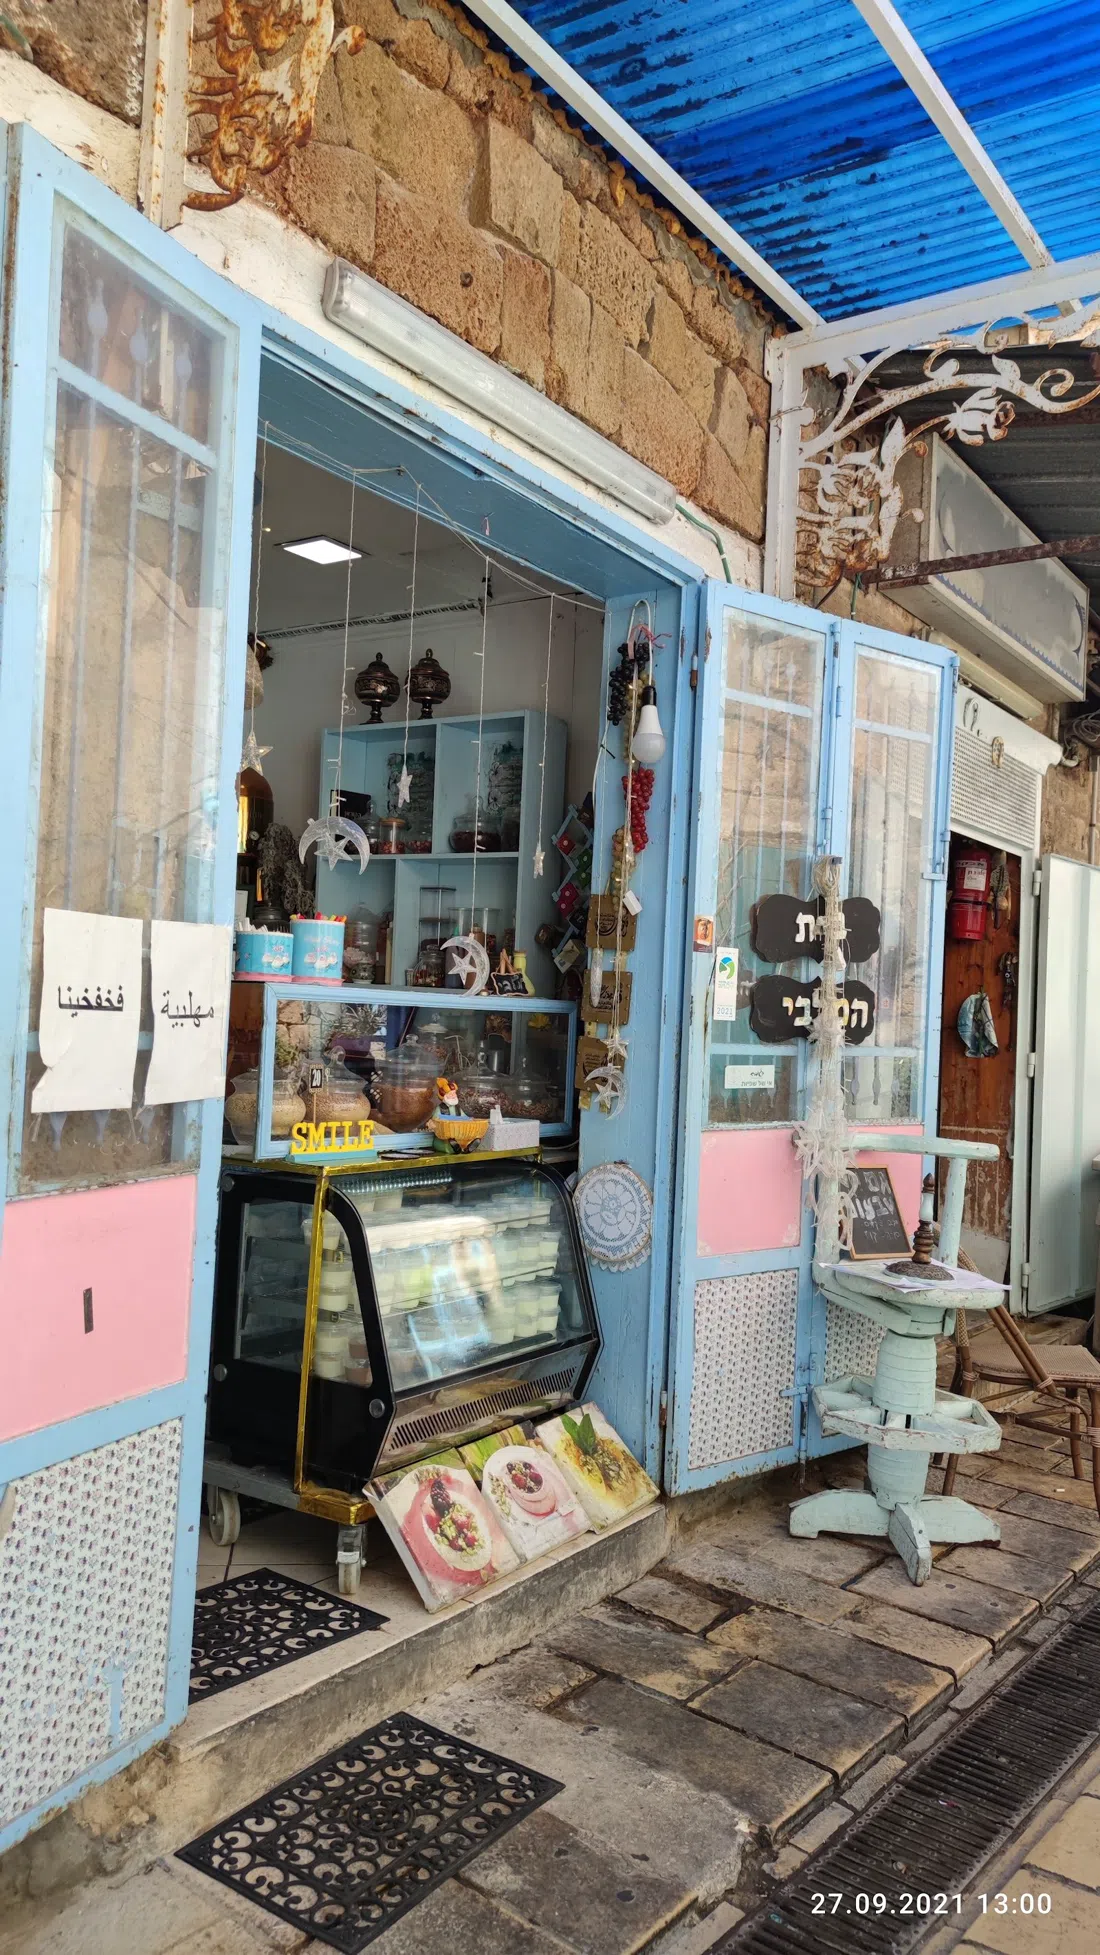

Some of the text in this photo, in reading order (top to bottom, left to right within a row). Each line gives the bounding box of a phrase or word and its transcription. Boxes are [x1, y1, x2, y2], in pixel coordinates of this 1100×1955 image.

[58, 985, 125, 1018] فخفخينا
[160, 990, 215, 1028] مهلبية
[716, 1006, 733, 1016] 2021
[311, 1068, 322, 1088] 20
[291, 1120, 375, 1154] SMILE
